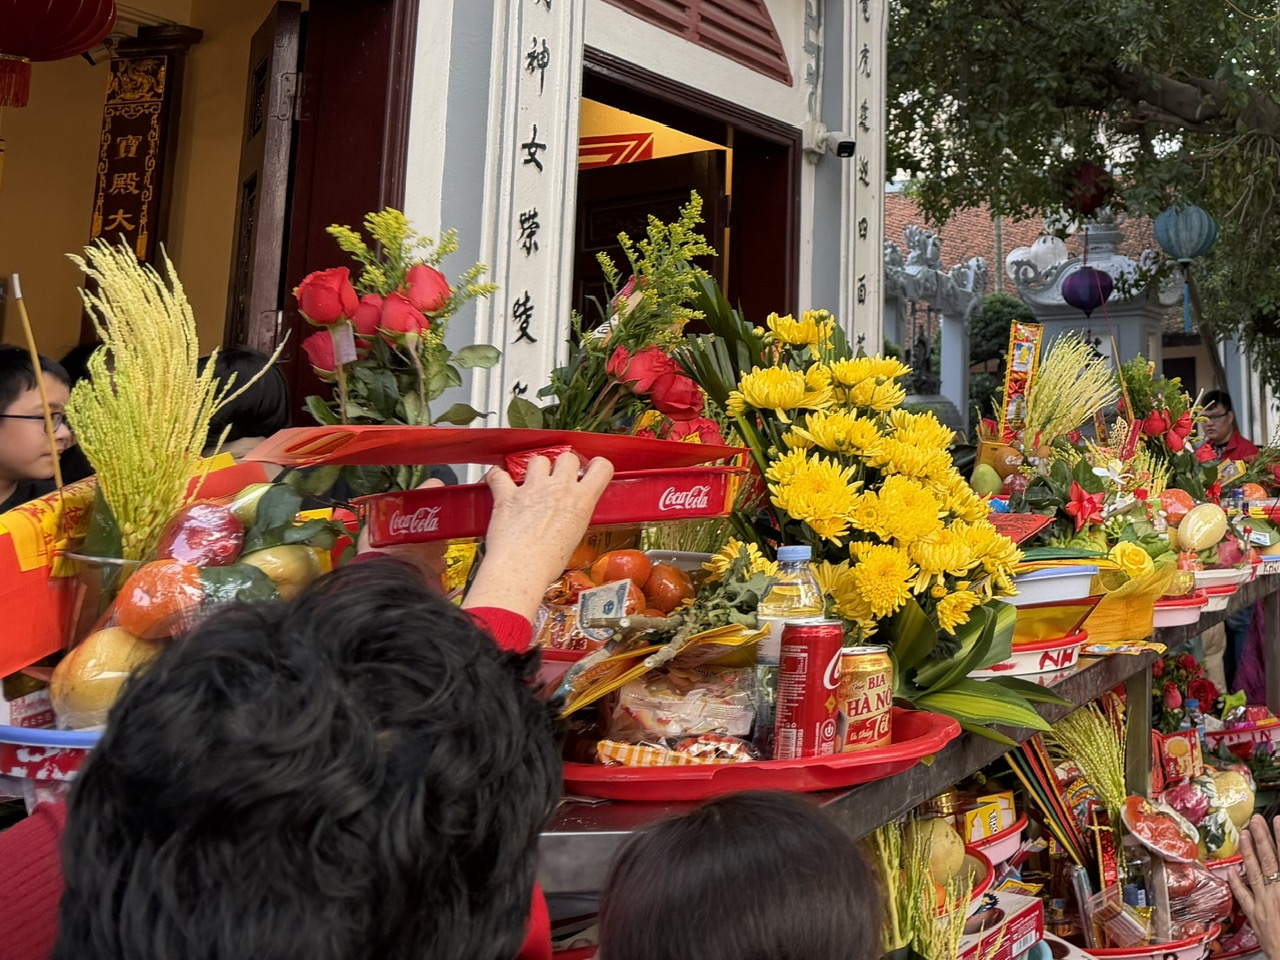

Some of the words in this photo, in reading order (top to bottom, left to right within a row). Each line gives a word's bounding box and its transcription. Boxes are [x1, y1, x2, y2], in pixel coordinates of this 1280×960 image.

[867, 673, 886, 691] BIA
[846, 692, 873, 718] HÀ
[874, 685, 893, 712] NỘ
